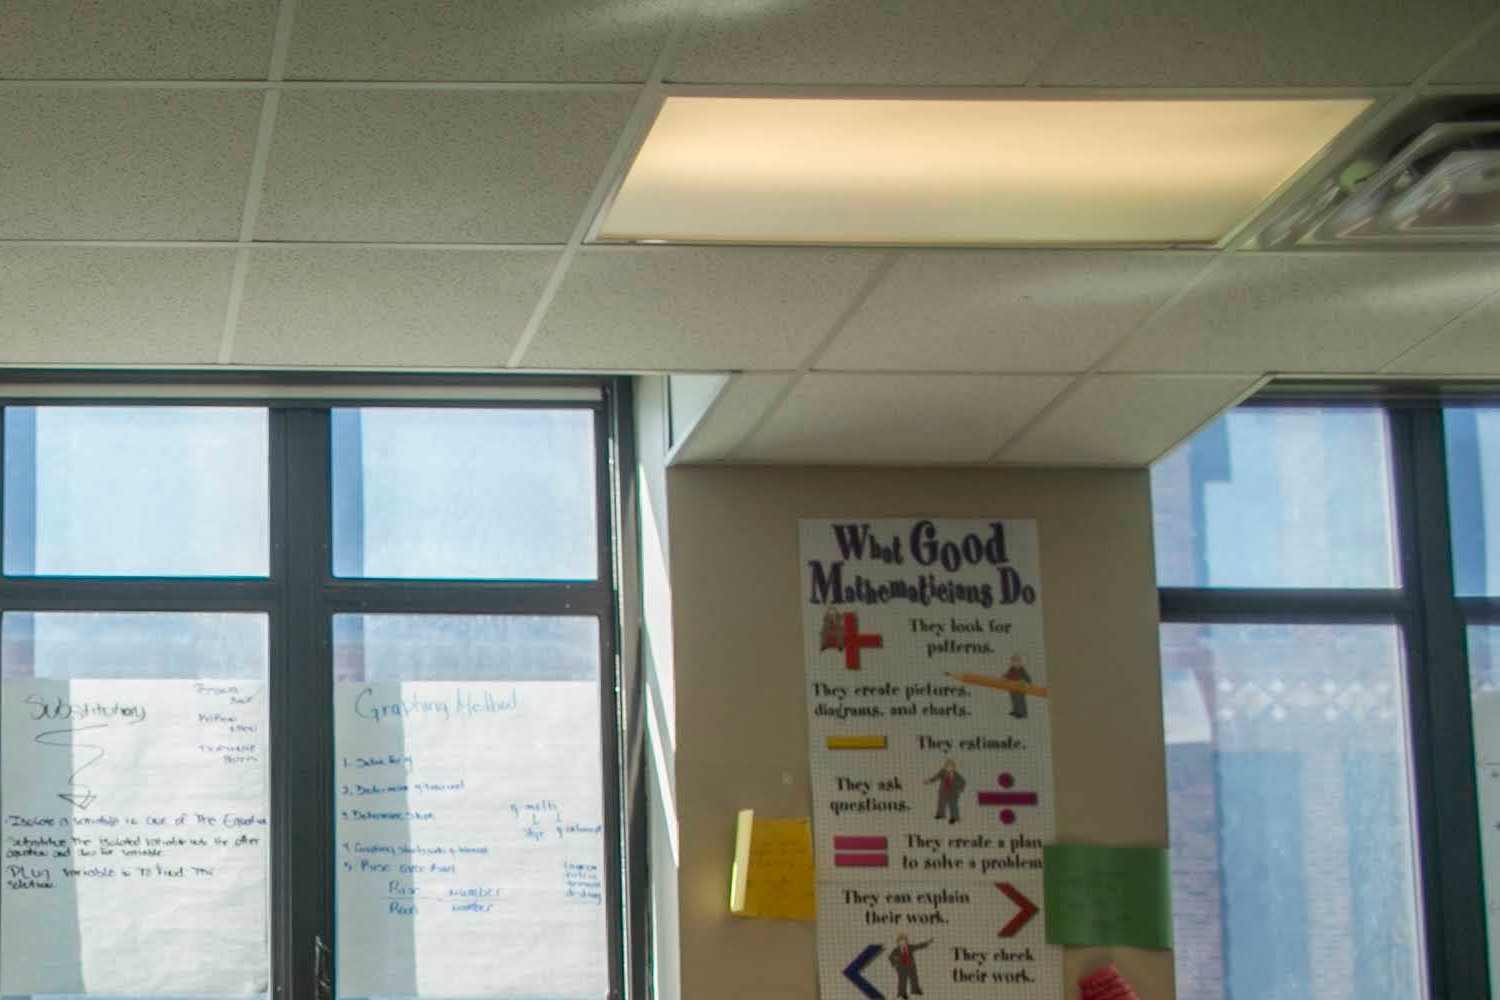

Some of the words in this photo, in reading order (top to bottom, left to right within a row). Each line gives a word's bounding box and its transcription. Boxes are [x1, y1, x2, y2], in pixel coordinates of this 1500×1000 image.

[831, 523, 904, 565] What
[910, 519, 1008, 572] Good
[808, 560, 993, 608] Mathematicians
[997, 565, 1036, 605] Do
[909, 618, 946, 636] They
[951, 618, 984, 633] look
[988, 618, 1012, 633] for
[927, 639, 994, 658] patterns.
[812, 683, 848, 700] They
[854, 683, 900, 697] create
[355, 688, 451, 721] Graphing
[889, 703, 917, 717] and
[921, 703, 972, 717] charts.
[918, 735, 954, 753] They
[959, 735, 1026, 750] estimate.
[837, 777, 872, 795] They
[878, 777, 902, 791] ask
[830, 799, 911, 816] questions.
[907, 834, 941, 852] They
[948, 834, 992, 849] create
[998, 838, 1005, 849] a
[1010, 834, 1043, 853] plan
[903, 855, 918, 869] to
[923, 854, 964, 870] solve
[969, 858, 977, 869] a
[843, 889, 879, 909] They
[886, 892, 911, 905] can
[917, 888, 970, 909] explain
[866, 911, 902, 925] their
[906, 911, 949, 925] work.
[953, 947, 987, 966] They
[993, 947, 1035, 962] check
[952, 968, 988, 983] their
[992, 968, 1035, 983] work.
